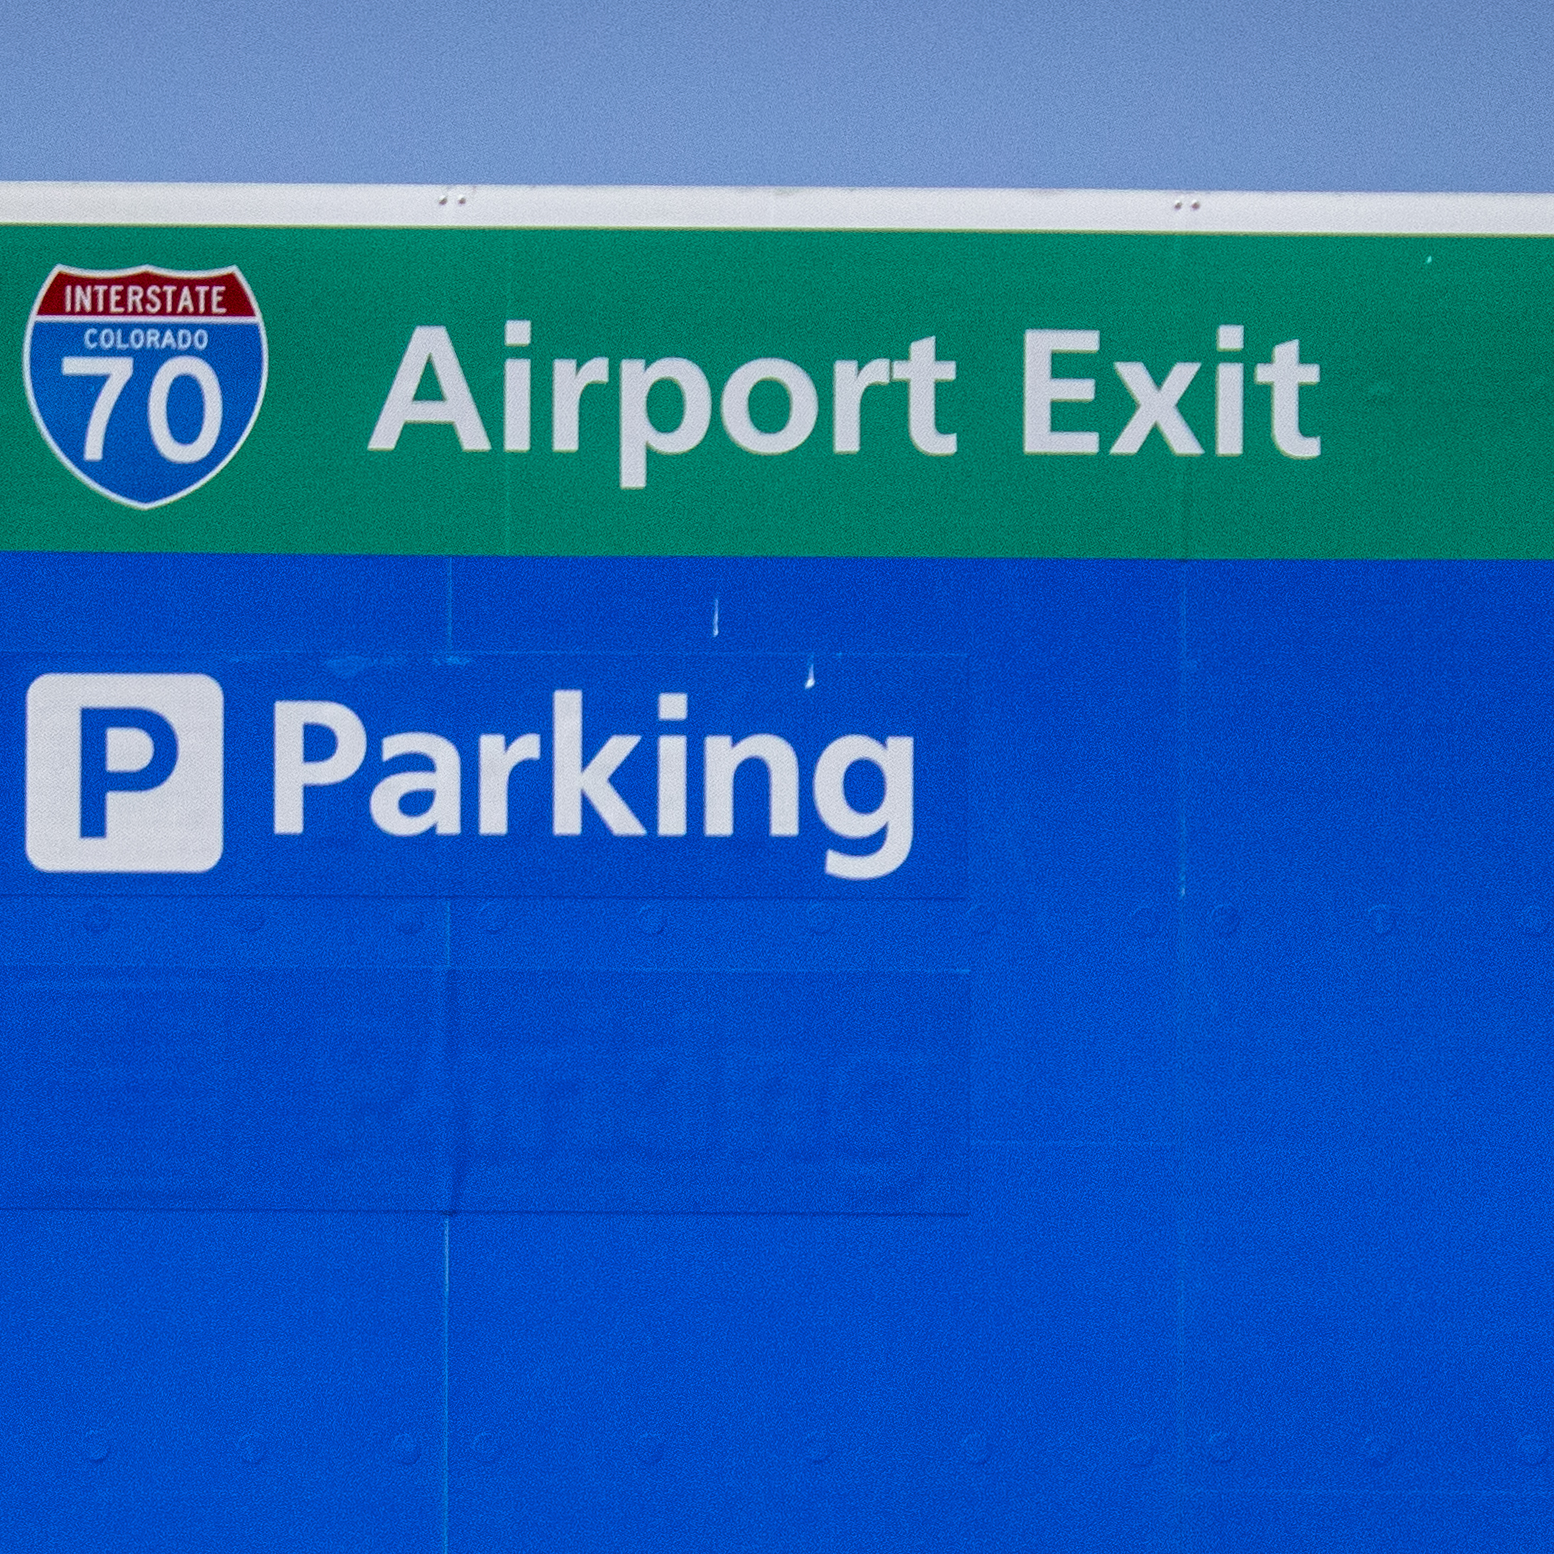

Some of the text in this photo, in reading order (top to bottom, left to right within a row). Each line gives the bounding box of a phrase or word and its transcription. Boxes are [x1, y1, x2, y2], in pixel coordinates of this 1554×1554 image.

[64, 283, 226, 316] INTERSTATE
[82, 328, 208, 352] COLORADO
[58, 354, 221, 466] 70
[369, 321, 1320, 488] Airport Exit
[80, 707, 178, 838] P
[275, 691, 912, 879] Parking
